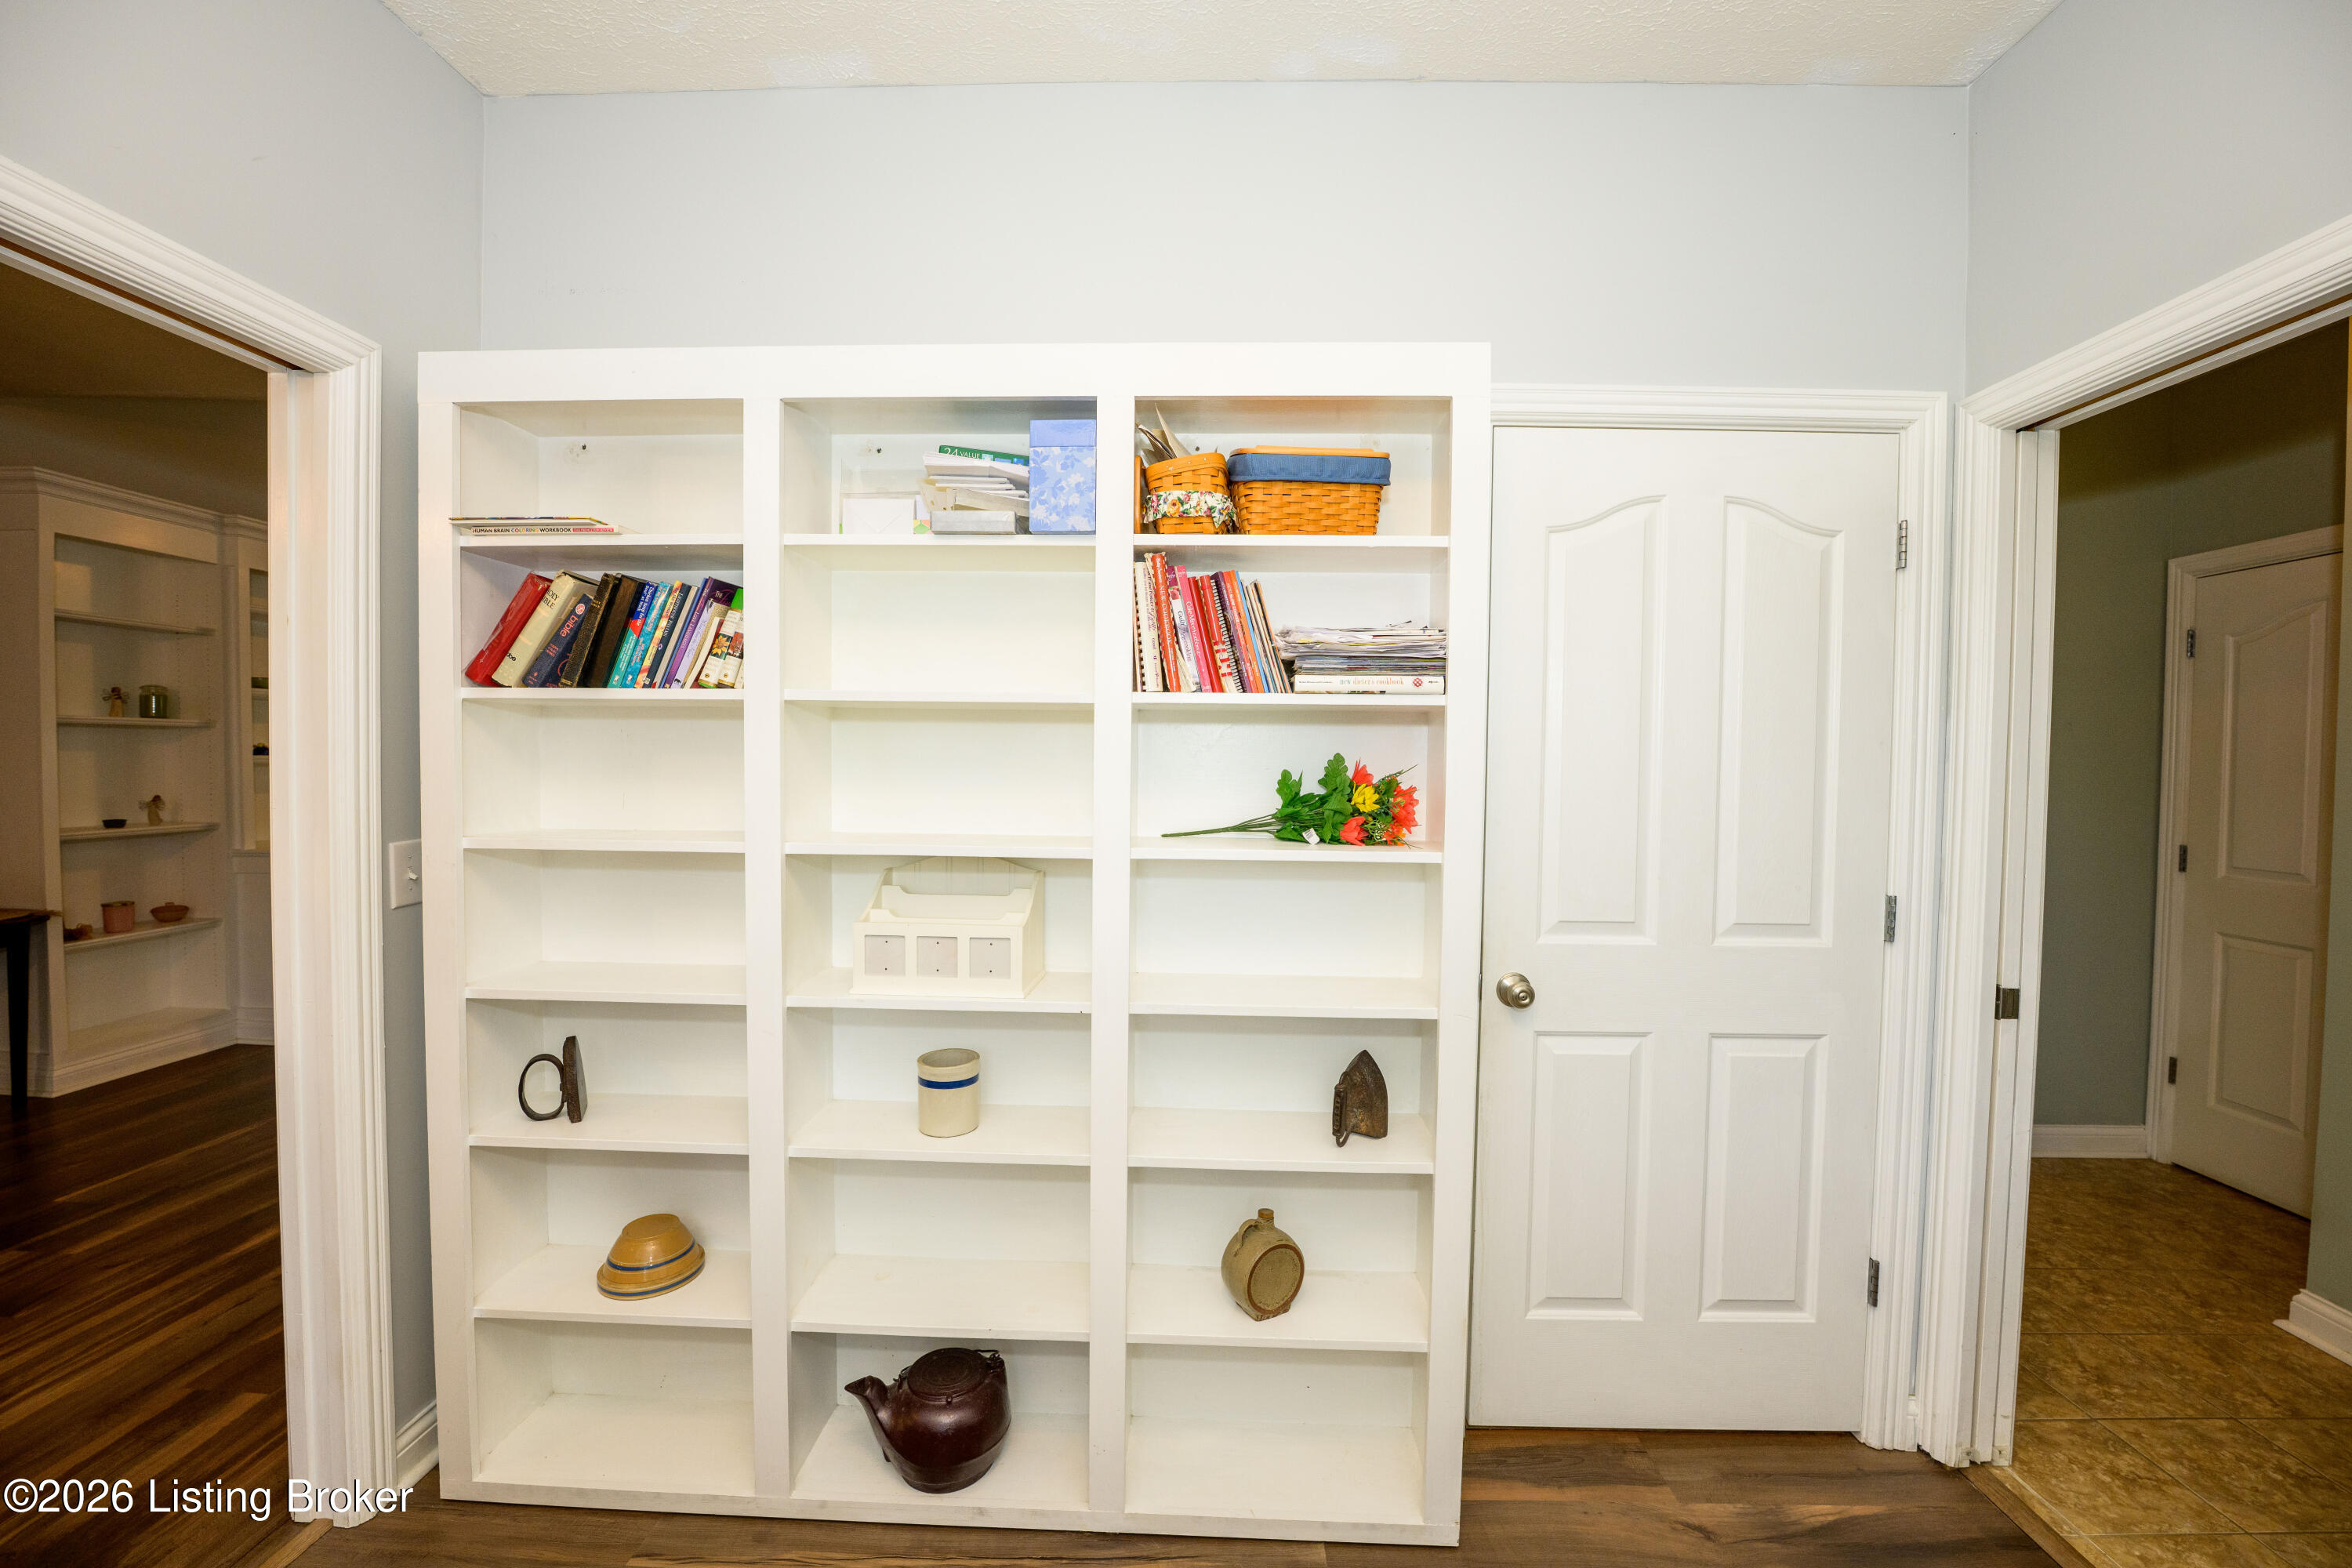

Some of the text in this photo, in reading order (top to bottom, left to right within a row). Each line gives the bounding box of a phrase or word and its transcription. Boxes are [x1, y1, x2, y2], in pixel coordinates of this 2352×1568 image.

[640, 601, 648, 612] Soup
[644, 586, 655, 603] Chicken
[670, 593, 683, 619] LIGHTHOUSE
[560, 615, 579, 637] bible
[1161, 603, 1172, 644] COOKBOOK
[681, 623, 694, 649] LANGUAGES
